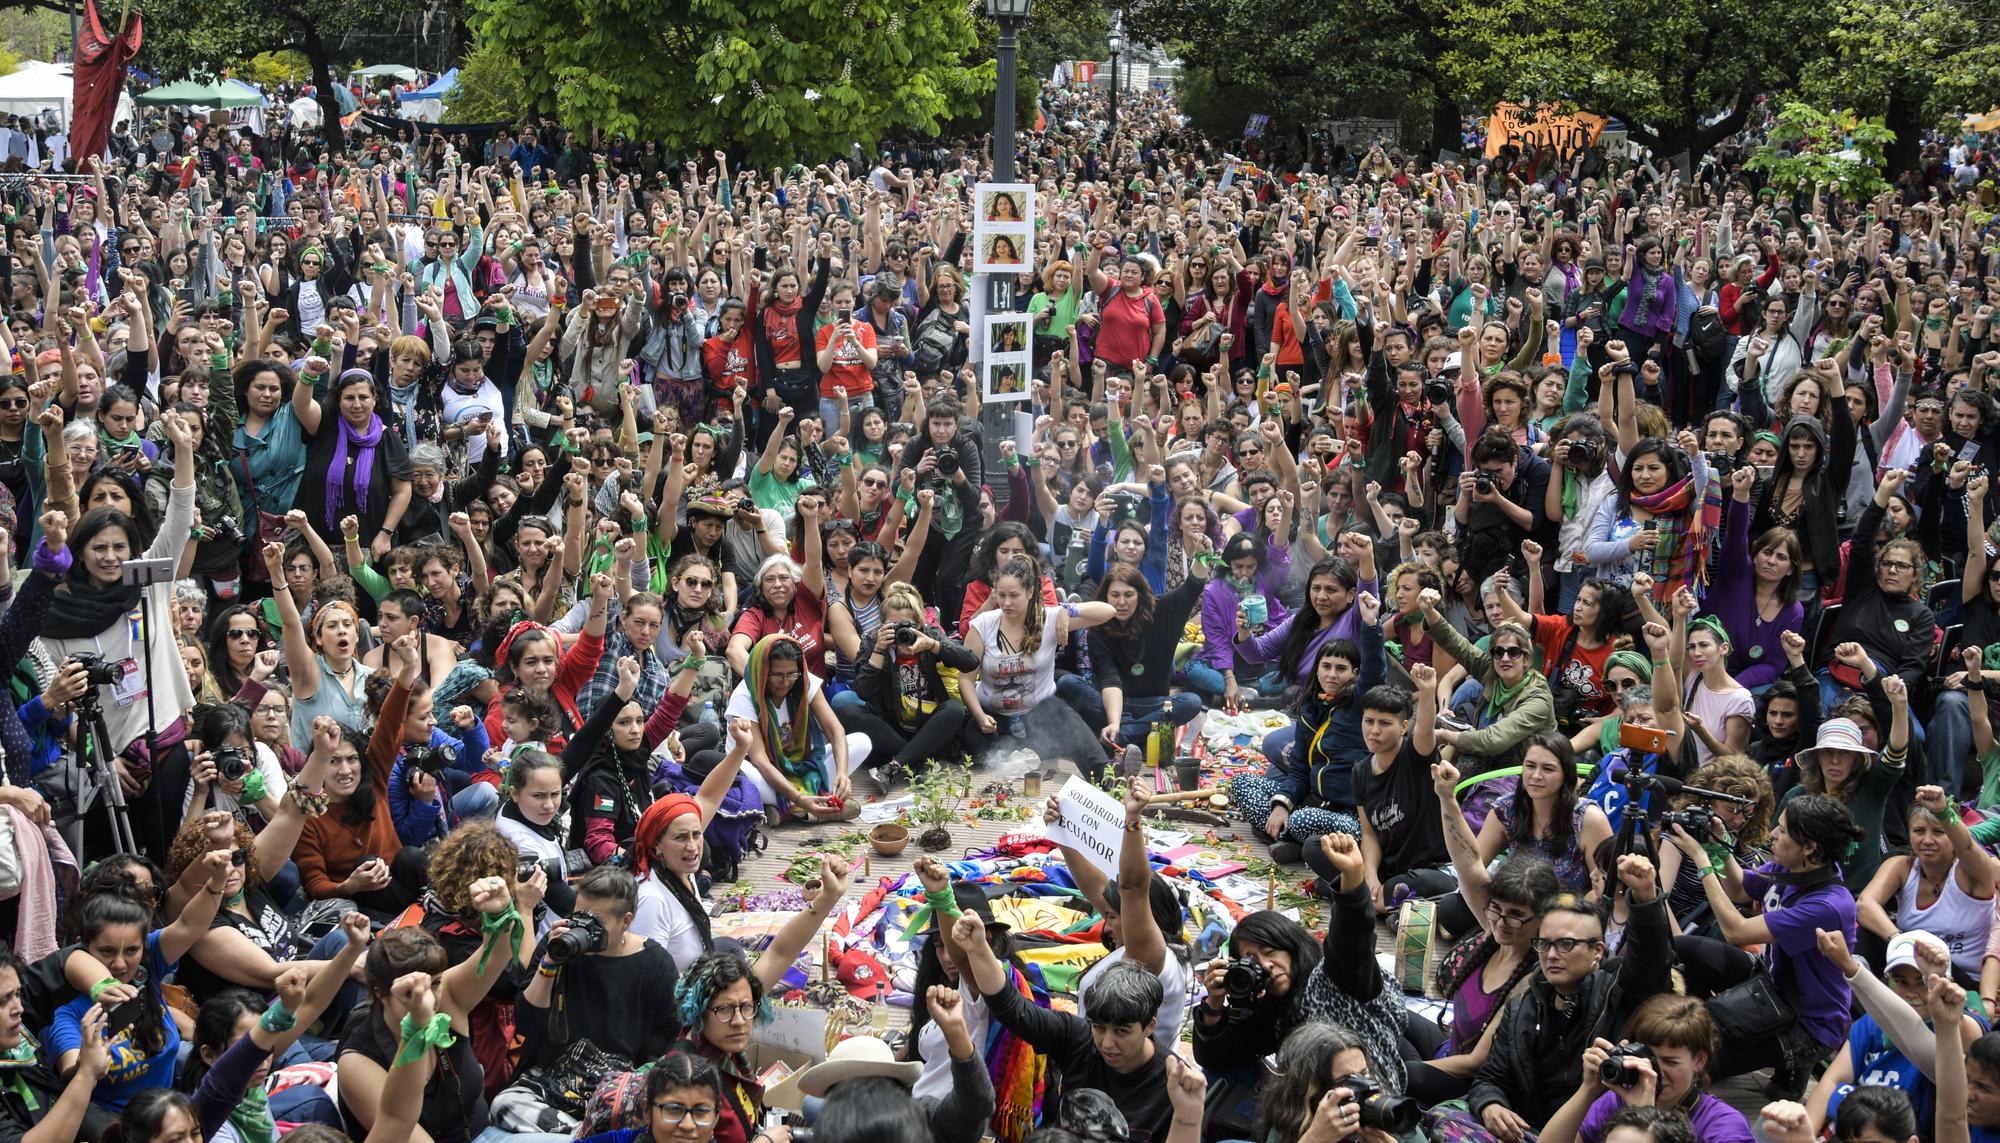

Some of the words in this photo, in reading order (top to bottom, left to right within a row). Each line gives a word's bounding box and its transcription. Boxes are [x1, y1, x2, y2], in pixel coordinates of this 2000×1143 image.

[1067, 788, 1124, 830] SOLIDARIDAD
[1081, 813, 1100, 831] CON
[1057, 814, 1114, 864] ECUADOR
